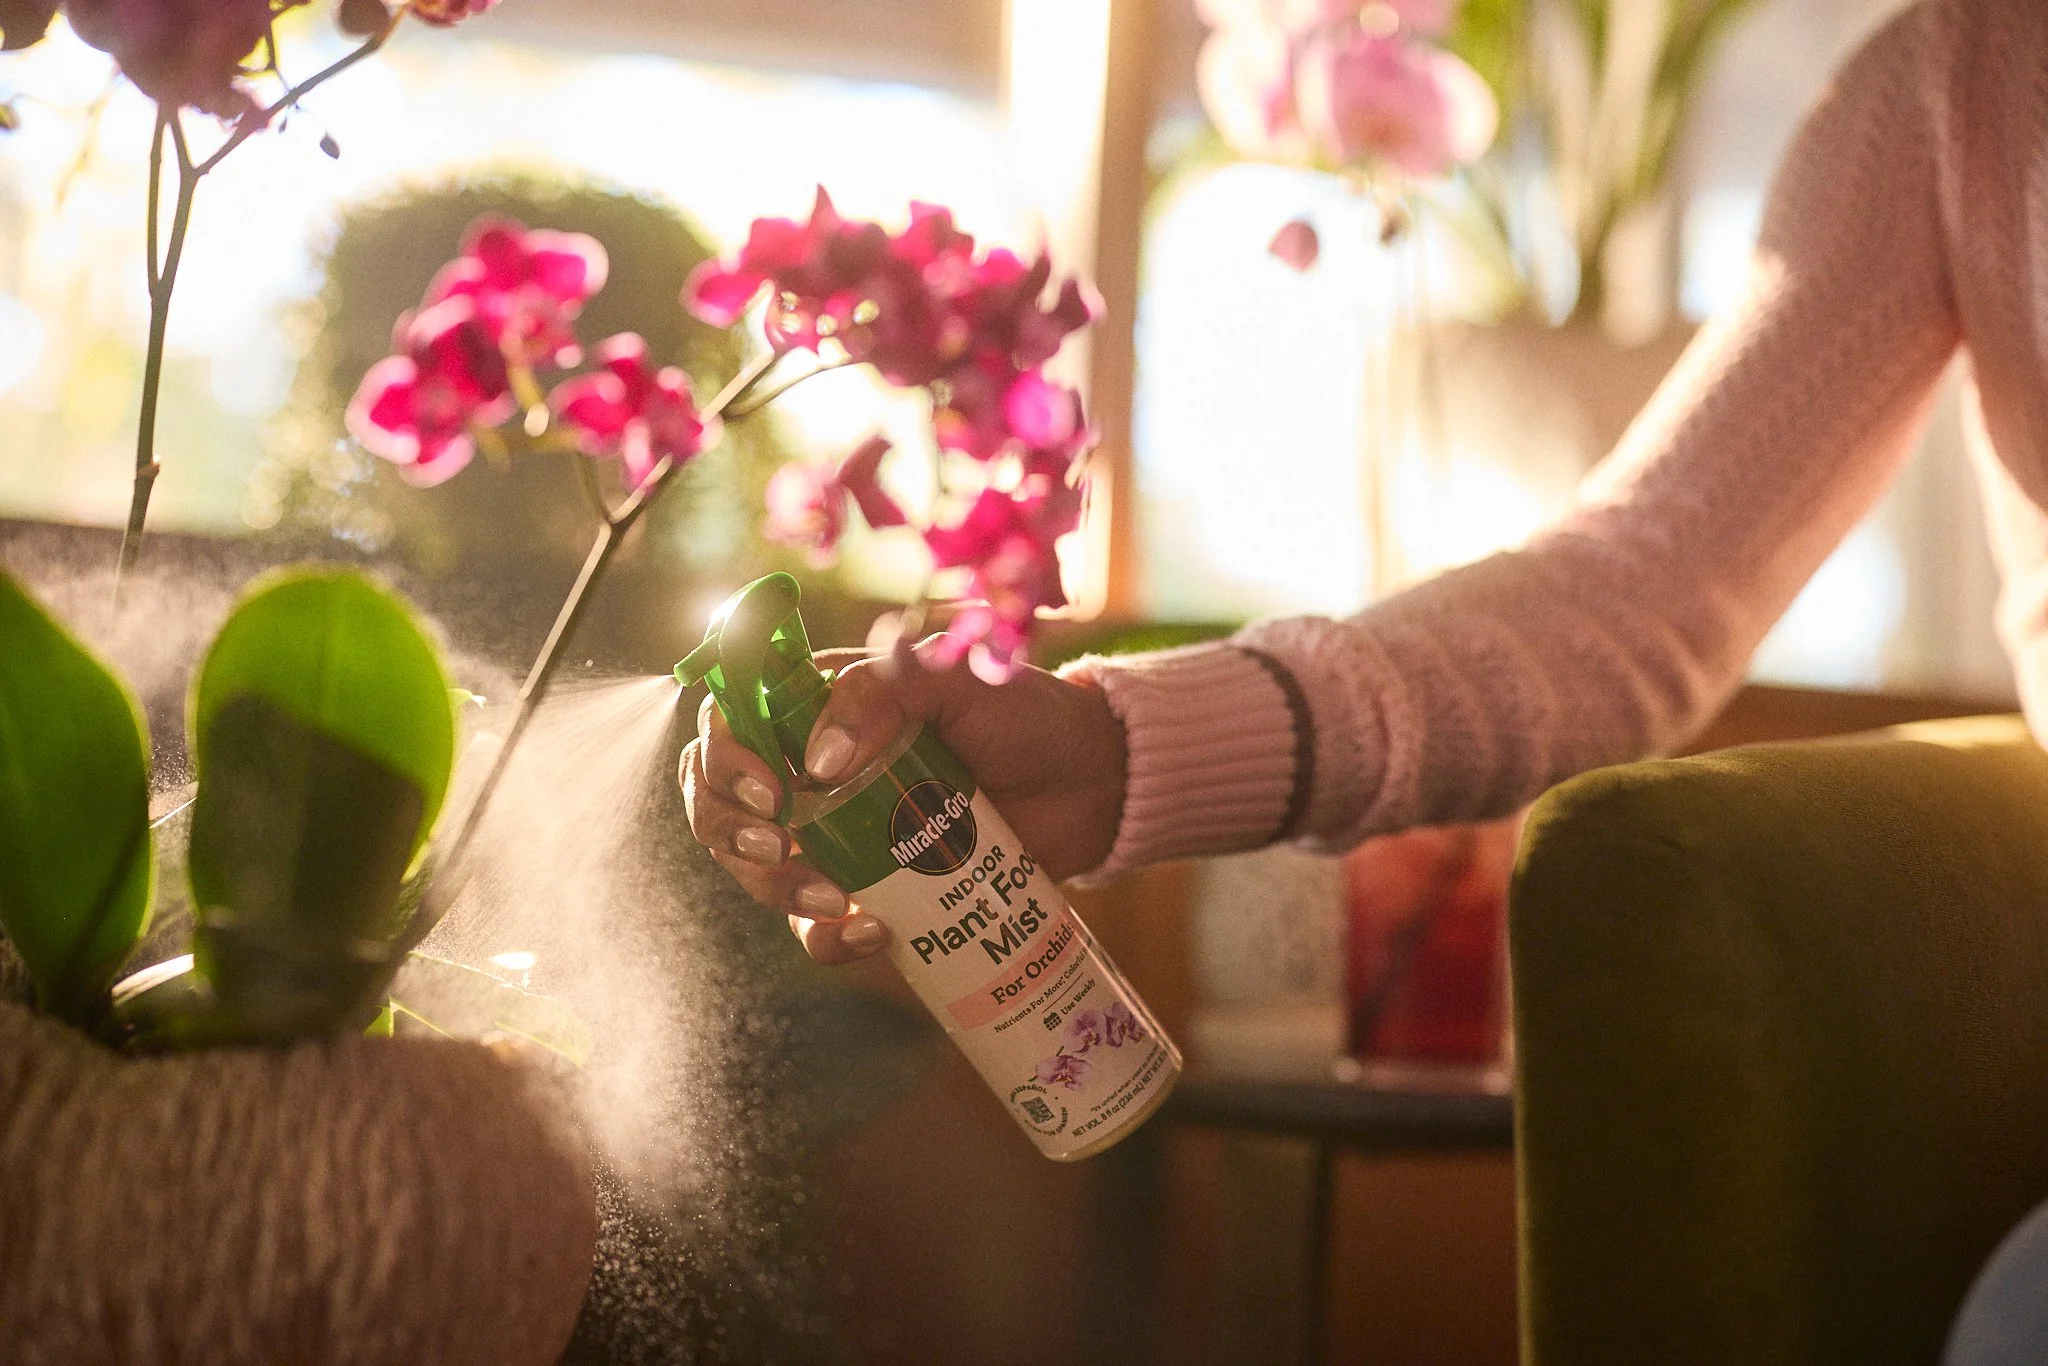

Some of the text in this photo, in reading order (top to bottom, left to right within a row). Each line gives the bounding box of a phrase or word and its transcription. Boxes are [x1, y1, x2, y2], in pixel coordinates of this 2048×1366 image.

[890, 791, 969, 867] Miracle-Gro
[938, 845, 1006, 911] INDOOR
[910, 898, 999, 965] Plant
[980, 897, 1048, 966] Mist
[990, 976, 1026, 1005] For
[994, 1007, 1032, 1033] Nutrients
[1030, 996, 1046, 1010] For
[1061, 978, 1096, 1015] Use Weekly
[1071, 1125, 1086, 1137] NET
